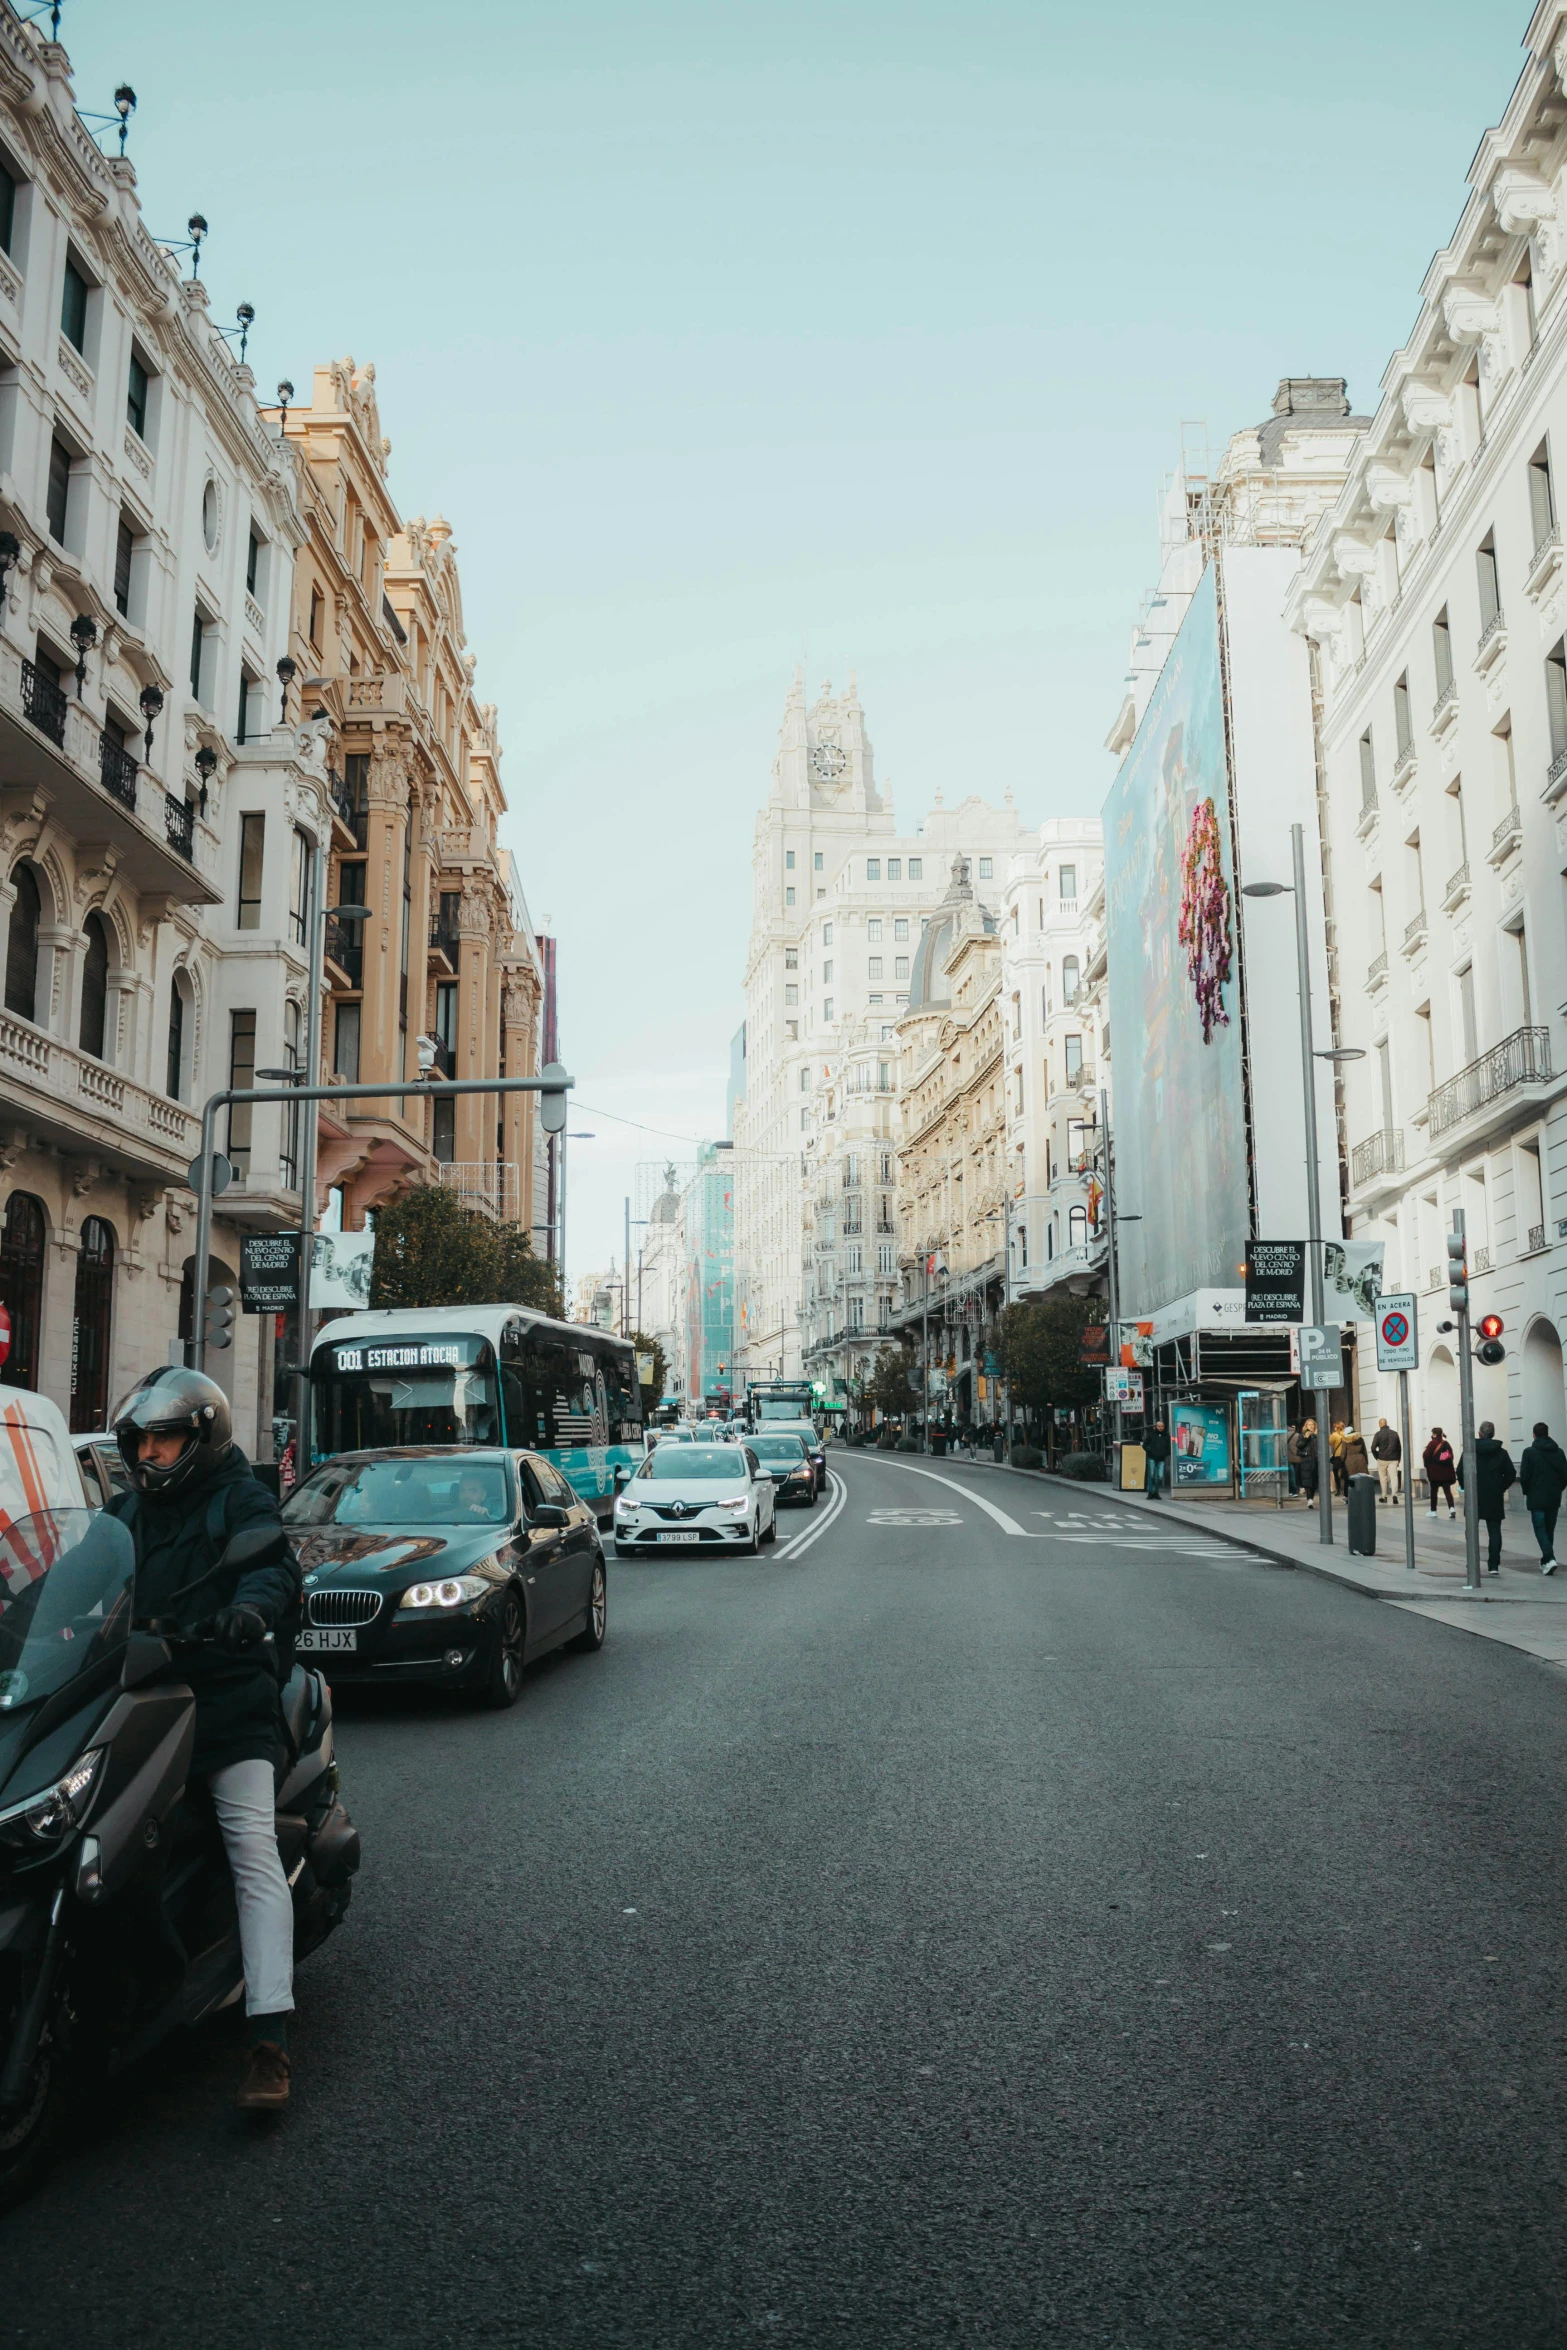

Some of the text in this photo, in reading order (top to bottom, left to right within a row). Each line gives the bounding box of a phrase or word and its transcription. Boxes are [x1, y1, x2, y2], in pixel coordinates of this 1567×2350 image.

[1300, 1328, 1325, 1361] P
[71, 1317, 79, 1394] kutxabank
[338, 1346, 459, 1370] 001 ESTACION ATOCHA
[1030, 1512, 1143, 1520] TAXI
[1053, 1521, 1161, 1530] BUS
[320, 1632, 352, 1648] HJX
